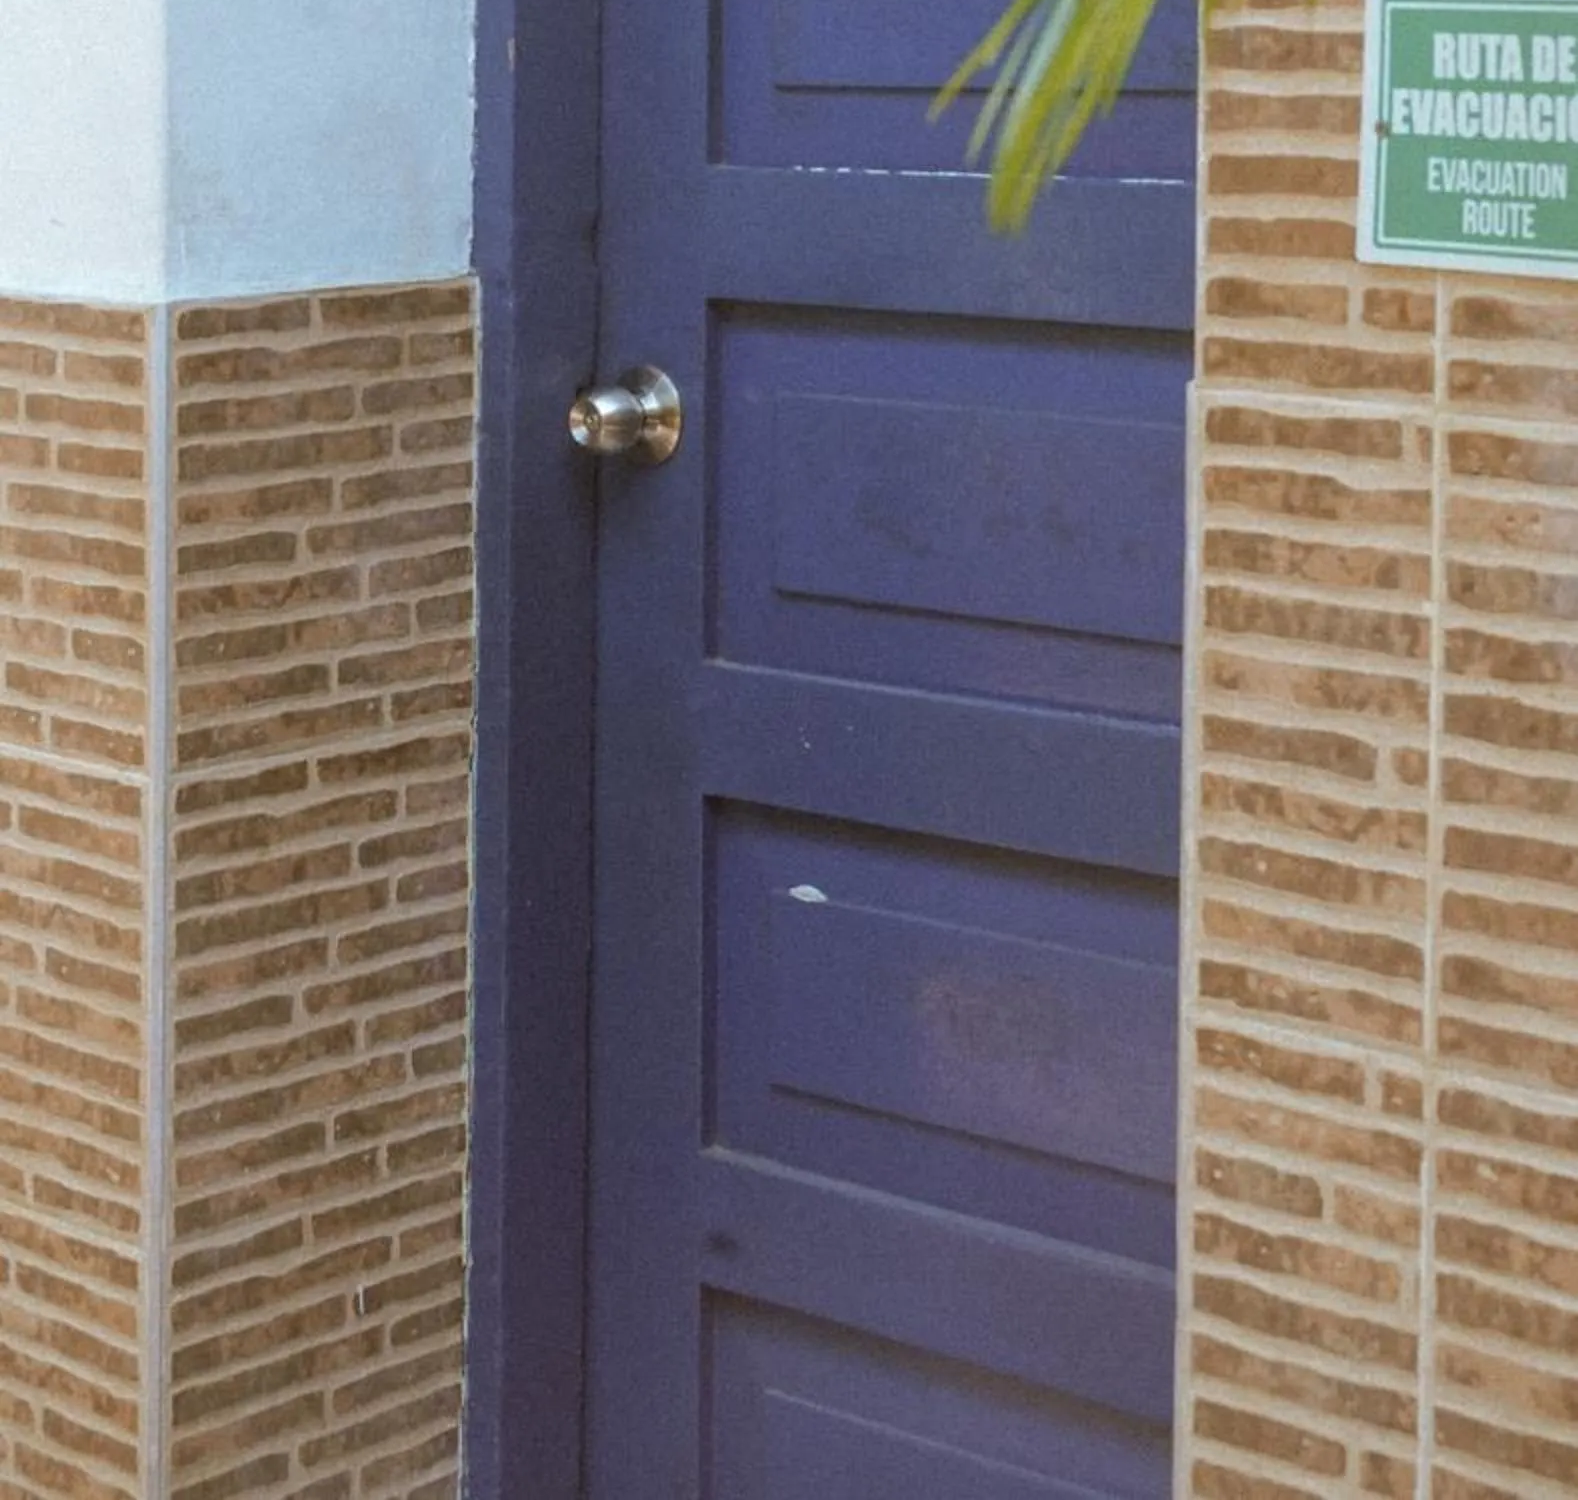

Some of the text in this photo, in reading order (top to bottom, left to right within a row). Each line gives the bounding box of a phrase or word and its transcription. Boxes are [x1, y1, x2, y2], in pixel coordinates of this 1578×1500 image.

[1432, 31, 1577, 84] RUTA DE
[1426, 156, 1568, 200] EVACUATION
[1461, 198, 1537, 239] ROUTE
